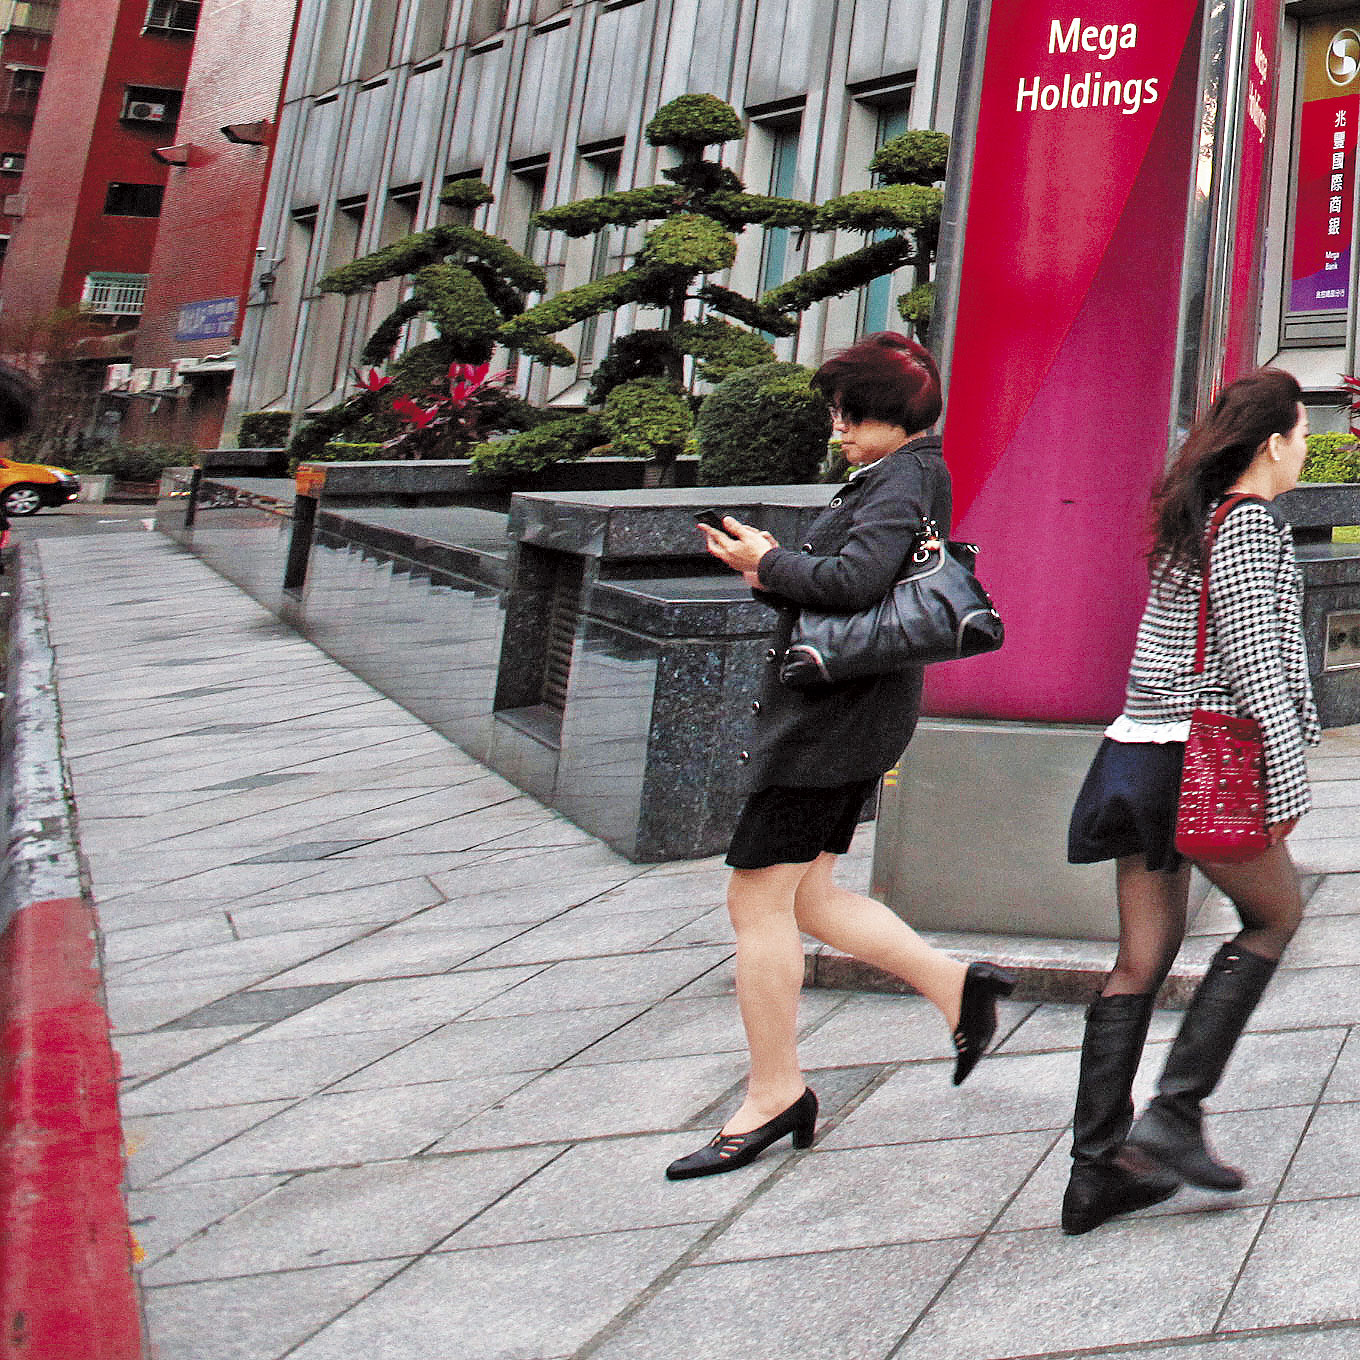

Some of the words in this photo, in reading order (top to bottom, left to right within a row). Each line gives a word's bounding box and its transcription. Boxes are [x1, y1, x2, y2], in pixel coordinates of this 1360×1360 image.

[1048, 17, 1137, 61] Mega
[1016, 71, 1159, 115] Holdings
[1327, 109, 1347, 235] 兆豐國際商銀
